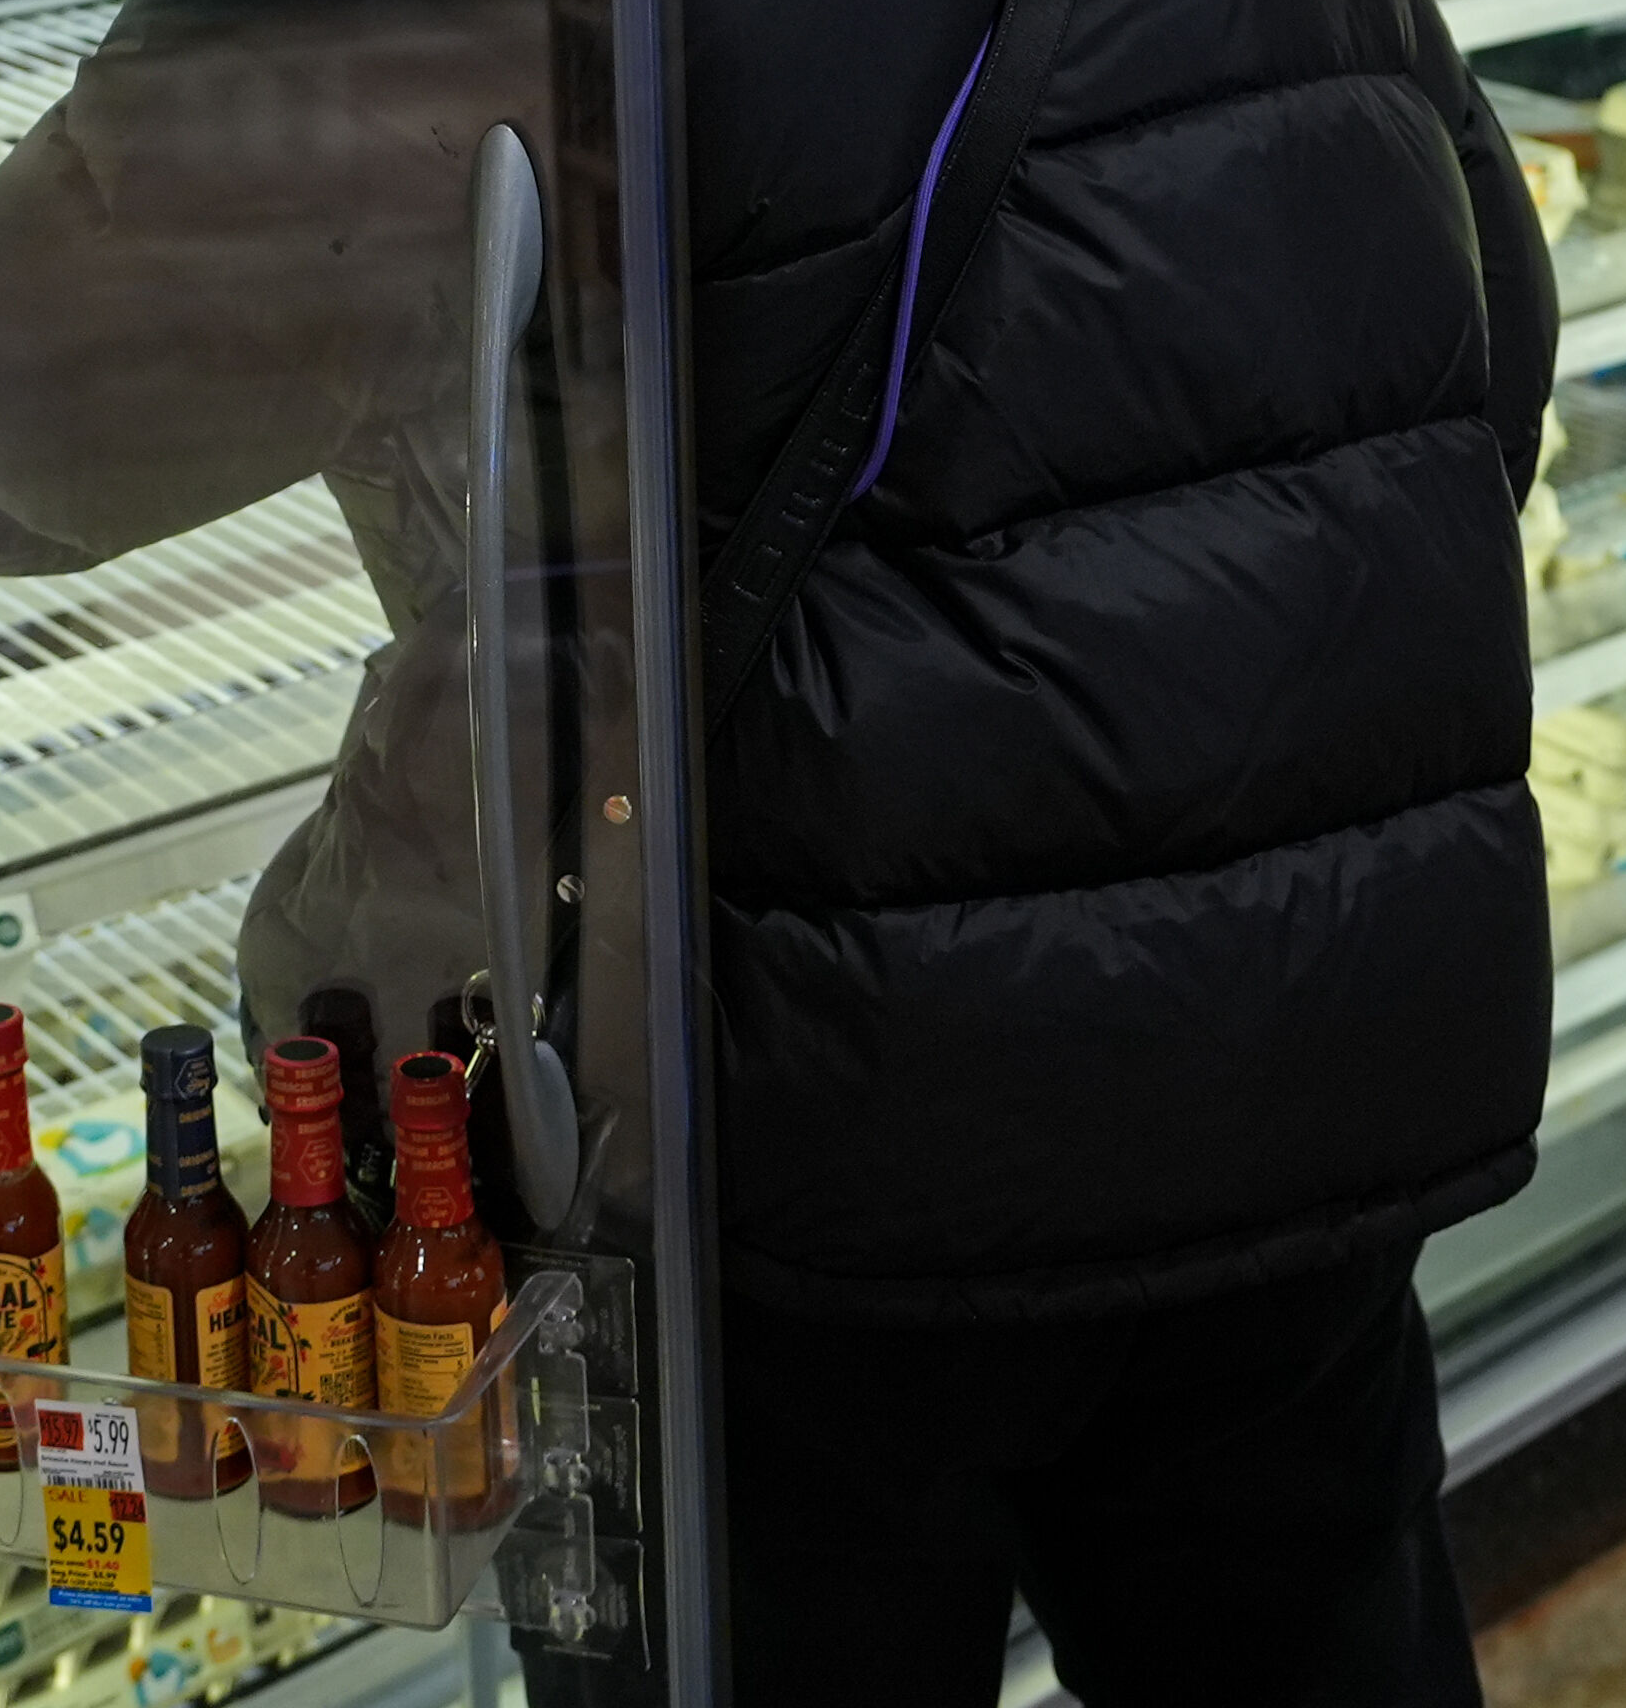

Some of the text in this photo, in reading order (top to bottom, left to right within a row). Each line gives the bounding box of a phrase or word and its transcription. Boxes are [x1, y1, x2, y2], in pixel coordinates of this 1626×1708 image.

[41, 1415, 79, 1446] $15.97
[88, 1418, 129, 1456] $5.99
[48, 1489, 86, 1503] SALE
[52, 1516, 124, 1554] $4.59
